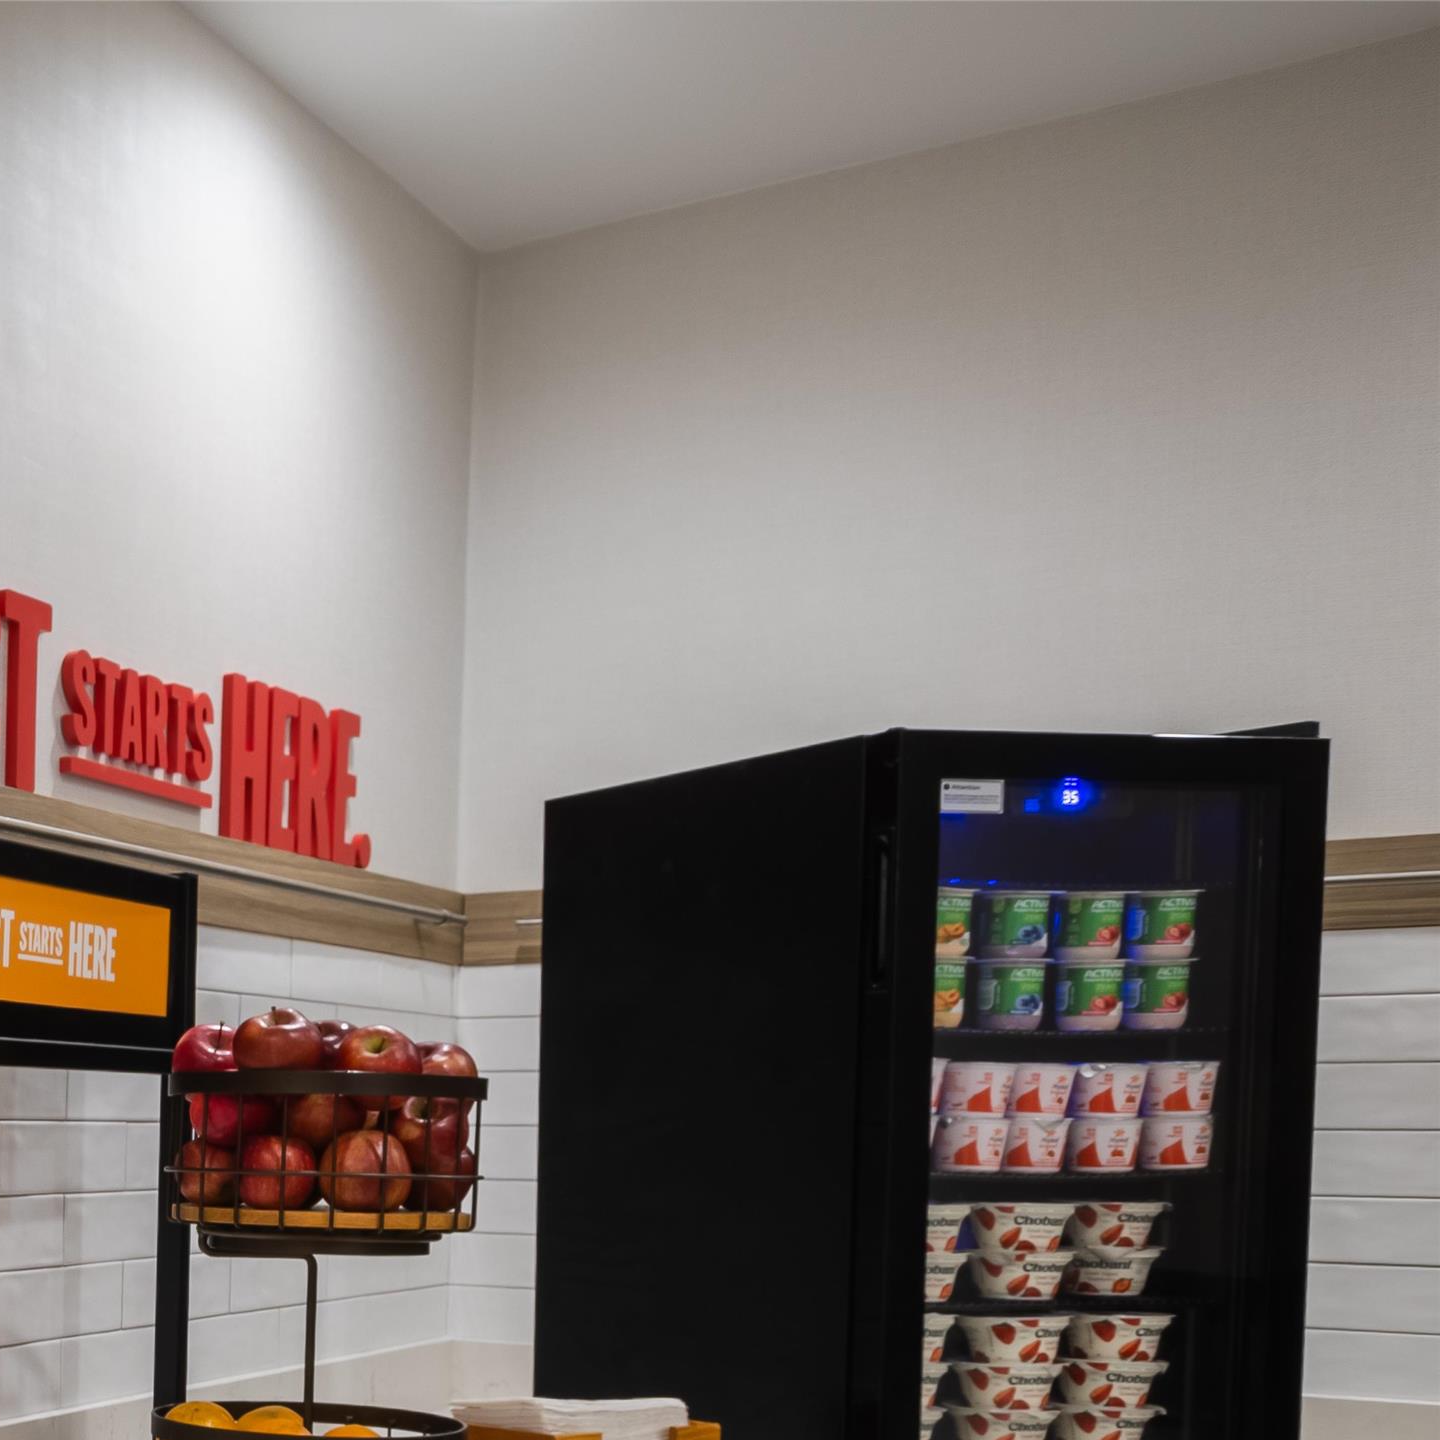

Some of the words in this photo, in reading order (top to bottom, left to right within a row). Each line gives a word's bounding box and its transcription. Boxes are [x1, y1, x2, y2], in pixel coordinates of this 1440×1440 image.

[60, 649, 213, 783] STARTS
[218, 673, 371, 868] HERE.
[19, 921, 64, 957] STARTS
[68, 921, 118, 982] HERE
